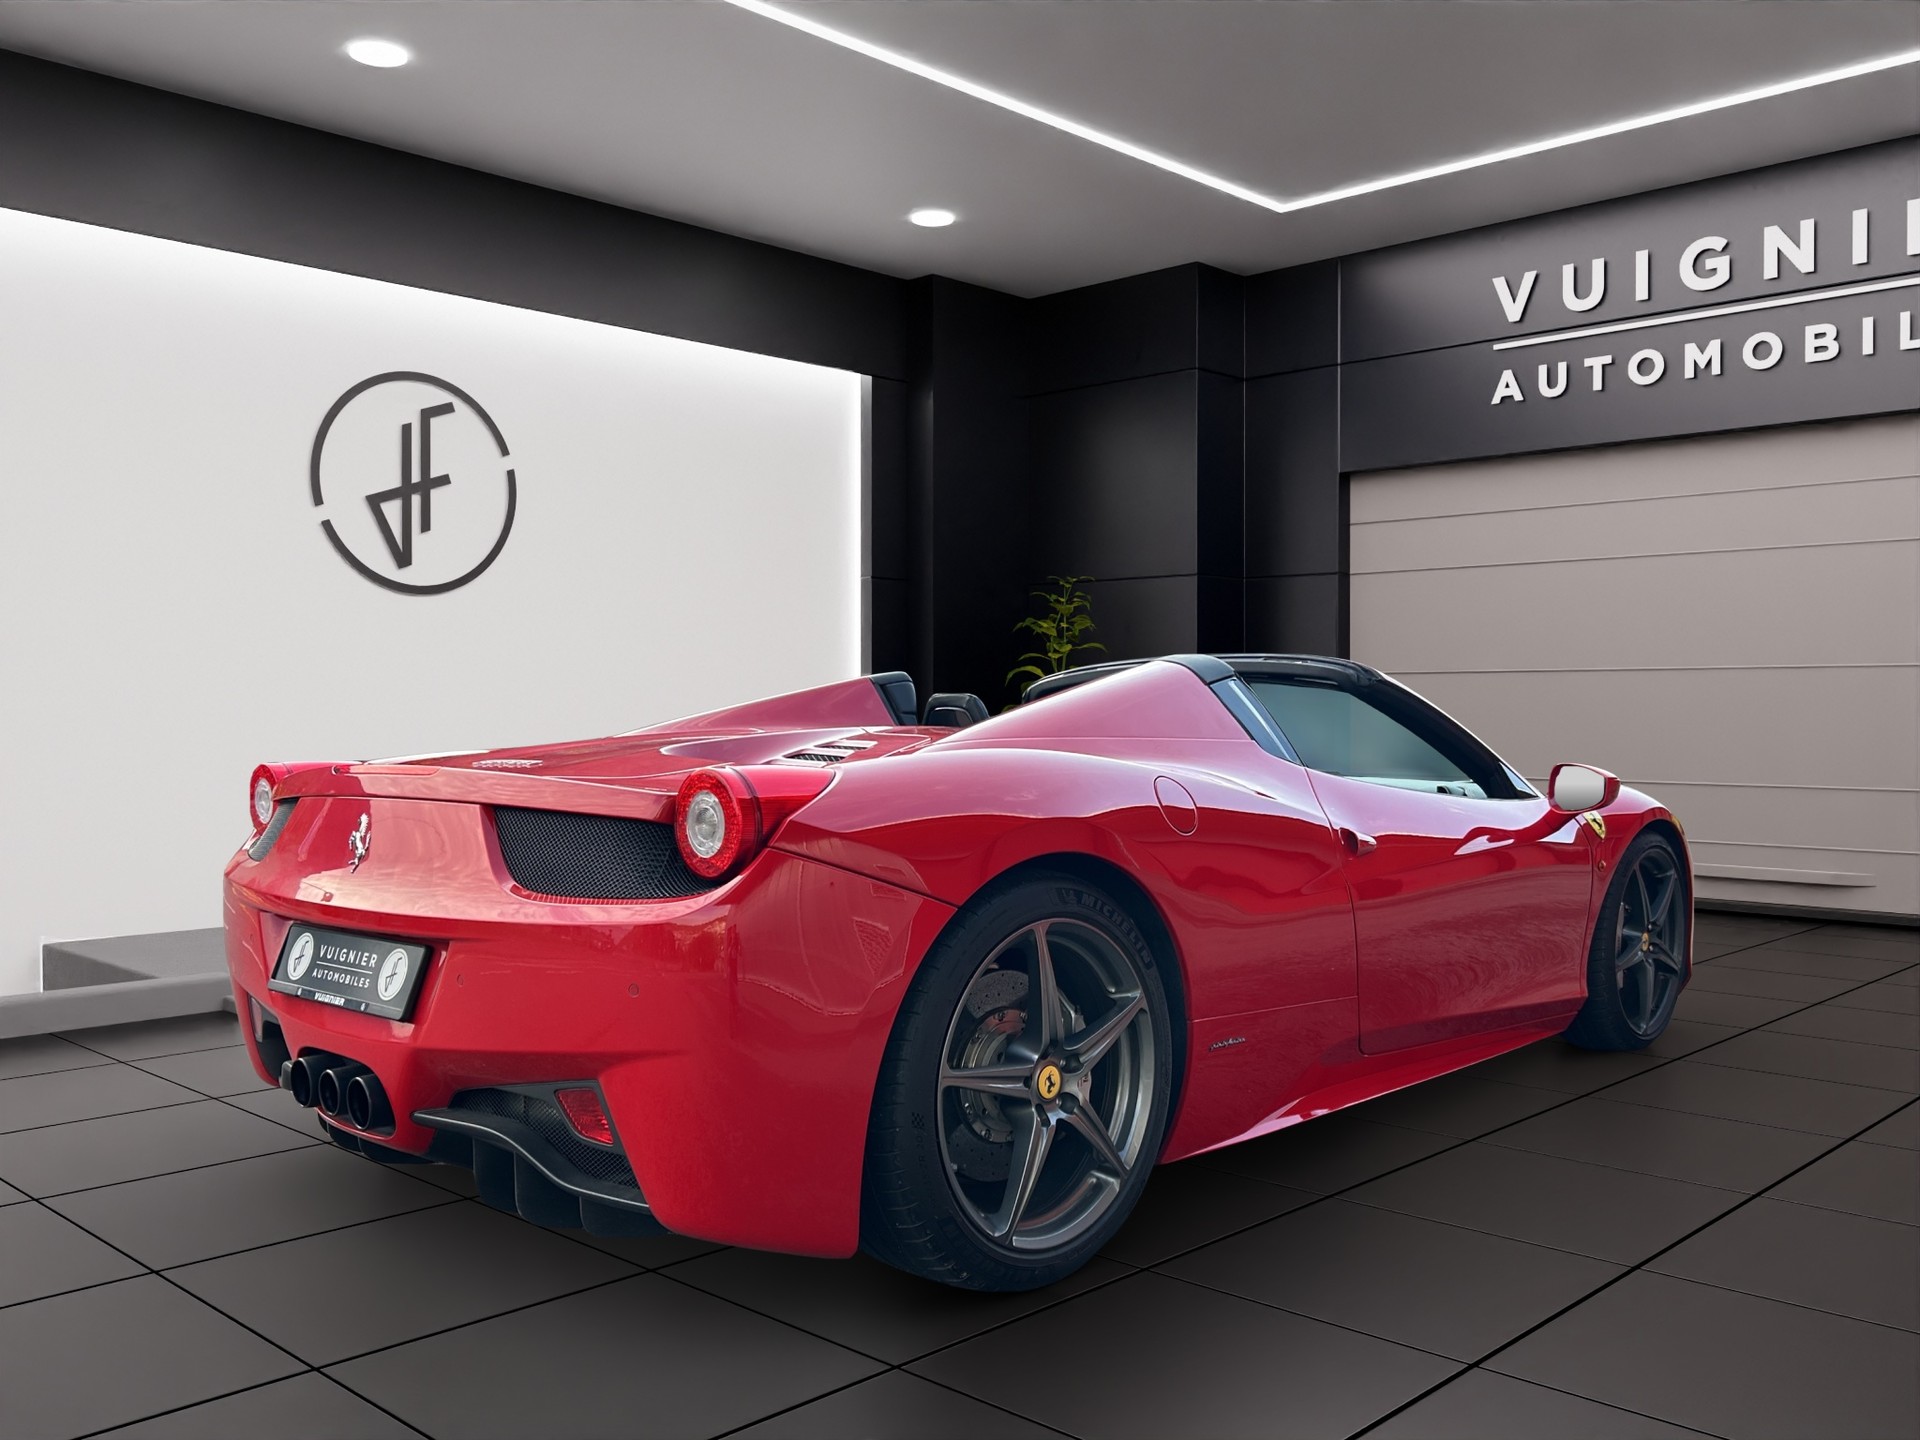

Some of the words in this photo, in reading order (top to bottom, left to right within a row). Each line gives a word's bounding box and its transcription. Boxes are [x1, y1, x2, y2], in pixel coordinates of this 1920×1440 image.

[1080, 892, 1151, 966] MICHELIN
[318, 944, 378, 968] VUIGNIER
[311, 967, 370, 989] AUTOMOBILES
